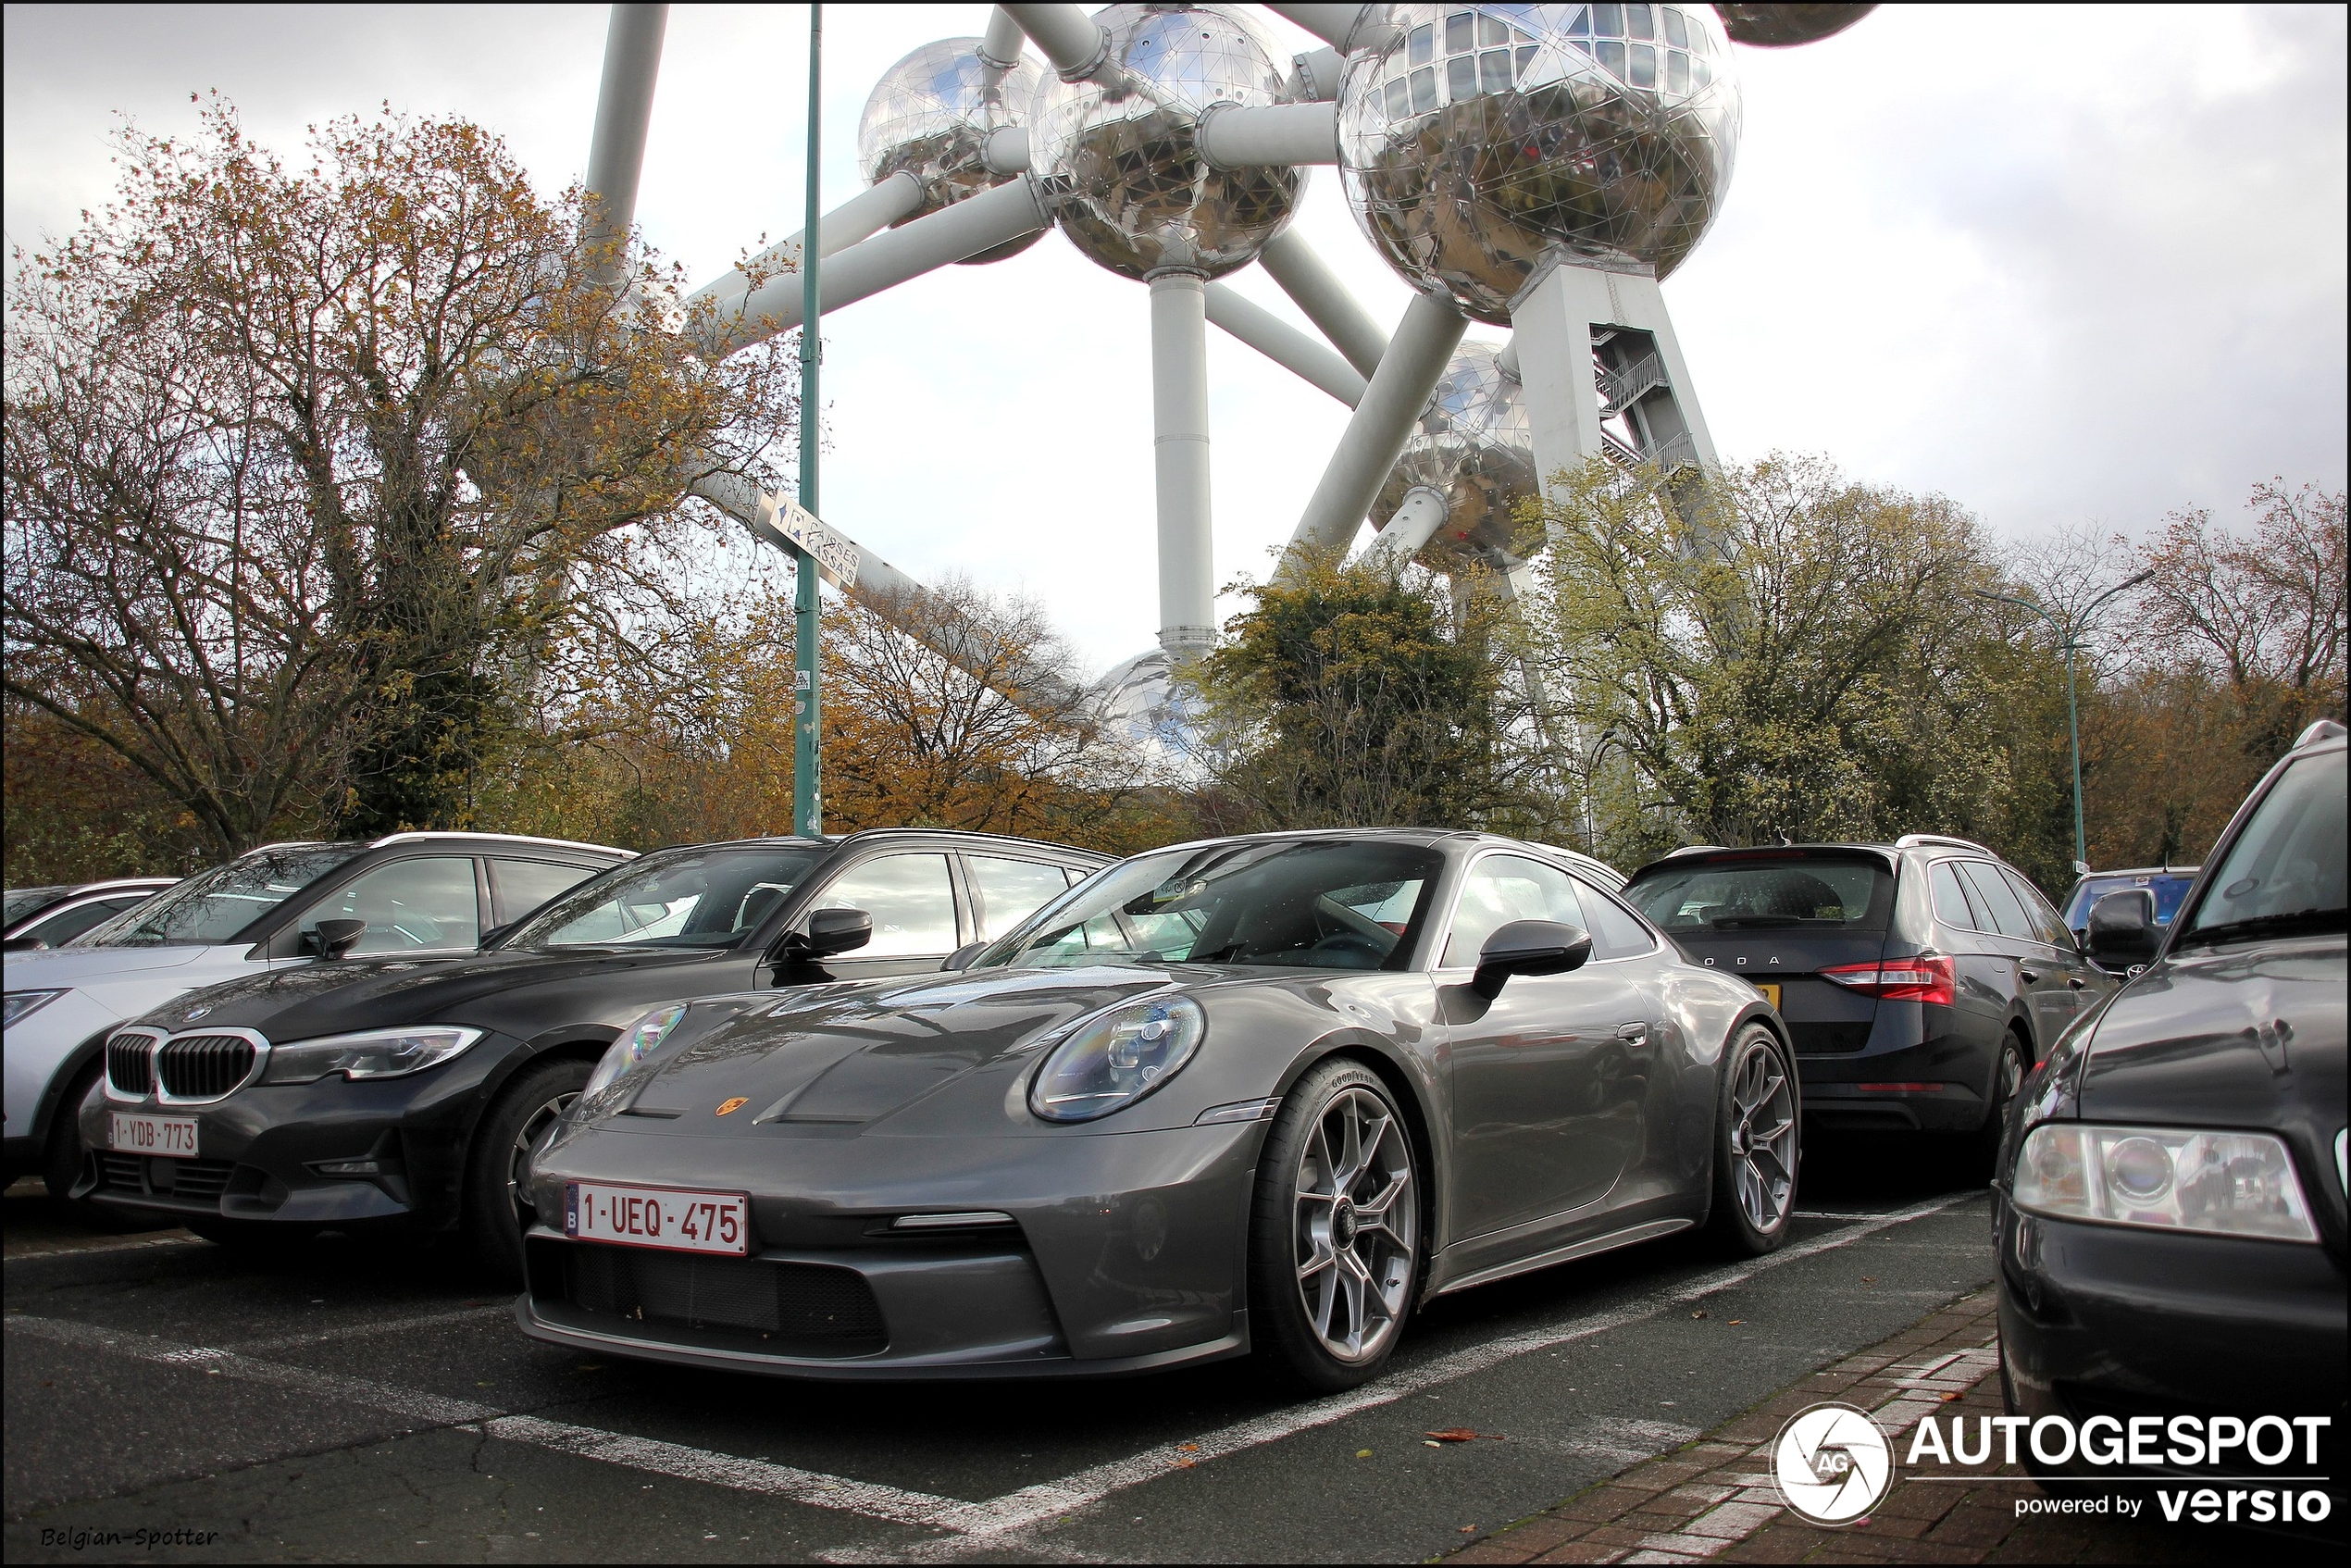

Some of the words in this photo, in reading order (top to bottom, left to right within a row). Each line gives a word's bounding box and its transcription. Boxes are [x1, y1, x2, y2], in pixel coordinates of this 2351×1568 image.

[806, 536, 854, 582] KASSA'S
[810, 522, 857, 567] CAISSES
[1704, 956, 1780, 966] ODA
[116, 1118, 194, 1151] 1-YDB-773
[567, 1212, 577, 1228] B
[584, 1193, 739, 1244] 1-UEQ-475
